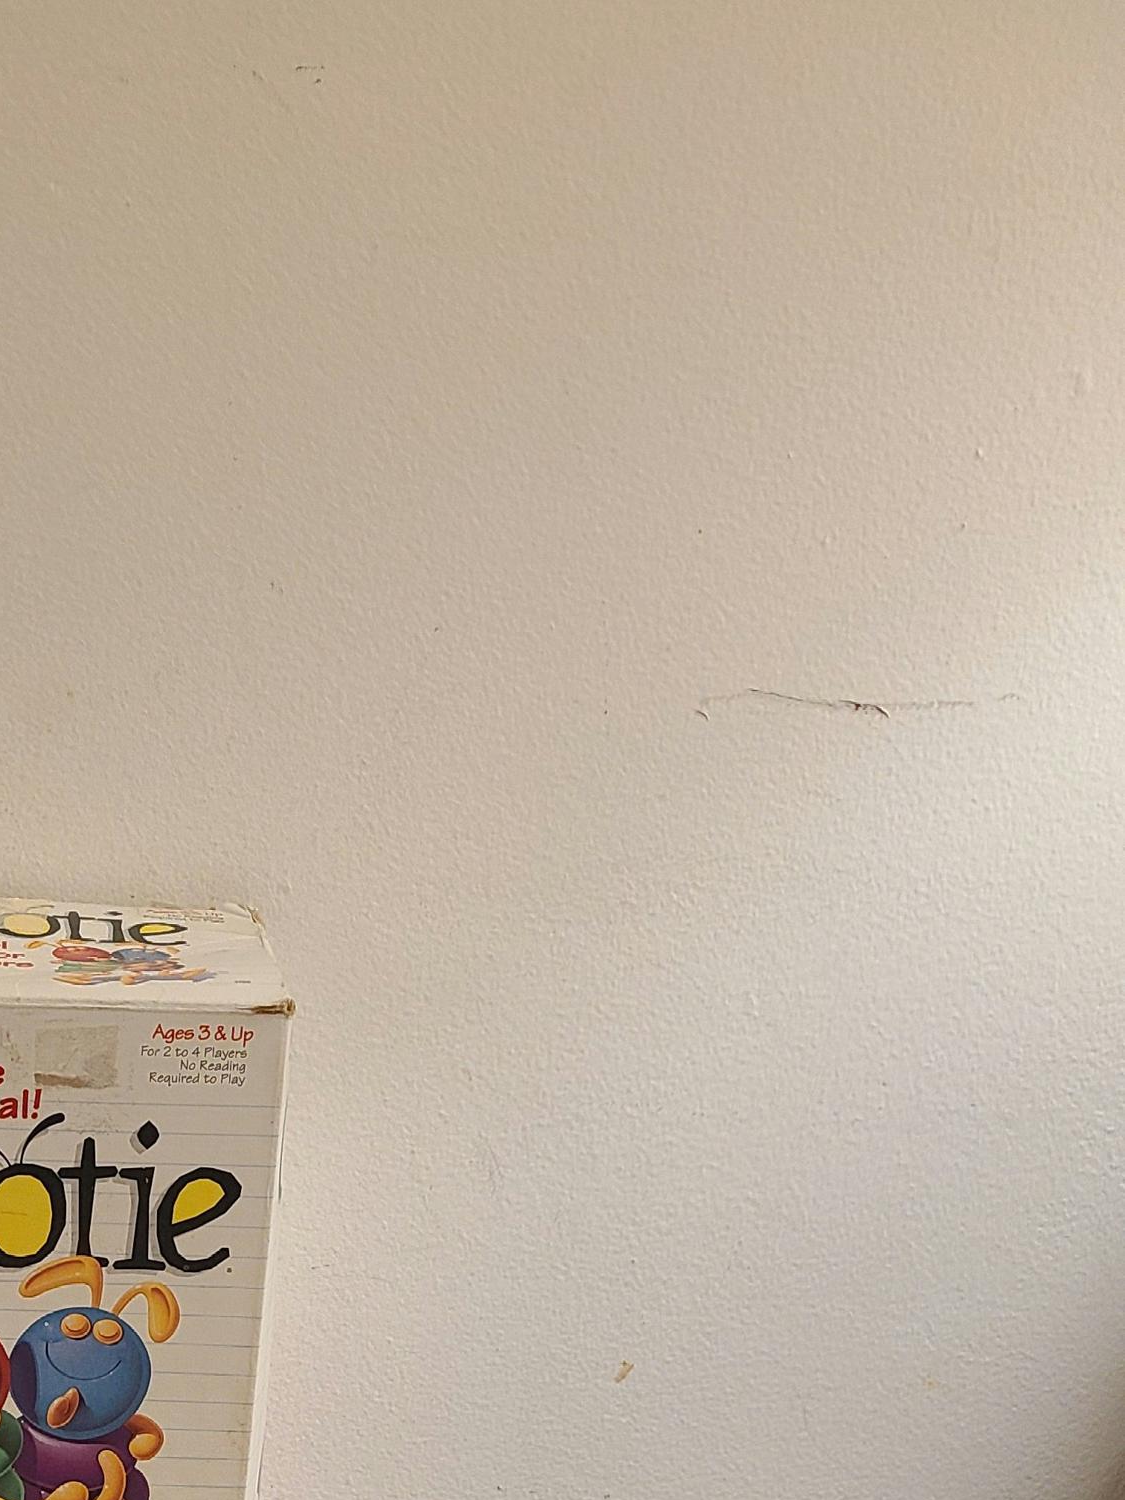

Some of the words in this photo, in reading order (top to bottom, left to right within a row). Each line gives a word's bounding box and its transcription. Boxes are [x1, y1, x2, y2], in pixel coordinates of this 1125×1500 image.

[152, 1024, 194, 1044] Ages
[197, 1025, 210, 1041] 3
[214, 1025, 227, 1041] &
[231, 1026, 254, 1048] Up
[140, 1045, 160, 1057] For
[163, 1045, 172, 1057] 2
[175, 1047, 189, 1057] to
[191, 1046, 200, 1057] 4
[204, 1046, 248, 1060] Players
[180, 1060, 196, 1071] No
[199, 1060, 246, 1074] Reading
[149, 1072, 200, 1087] Required
[203, 1073, 217, 1084] to
[220, 1073, 246, 1087] Play
